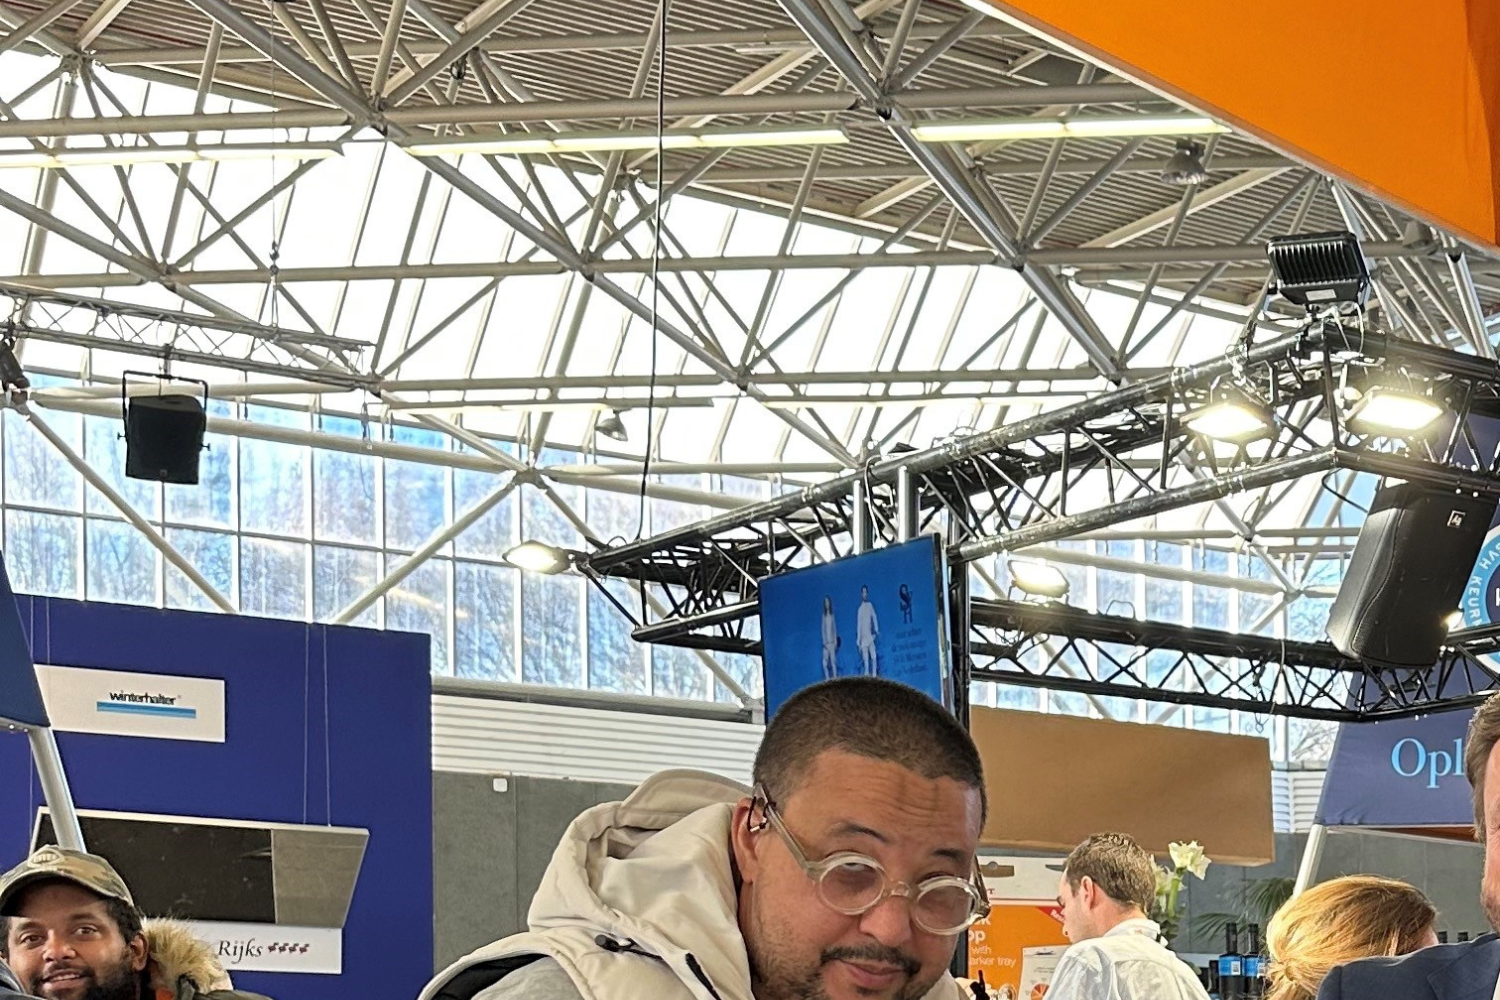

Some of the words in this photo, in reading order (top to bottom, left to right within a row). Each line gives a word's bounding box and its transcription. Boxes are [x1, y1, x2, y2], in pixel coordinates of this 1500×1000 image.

[109, 689, 176, 706] winterhalter
[218, 938, 264, 965] Rijks
[968, 957, 995, 966] arker
